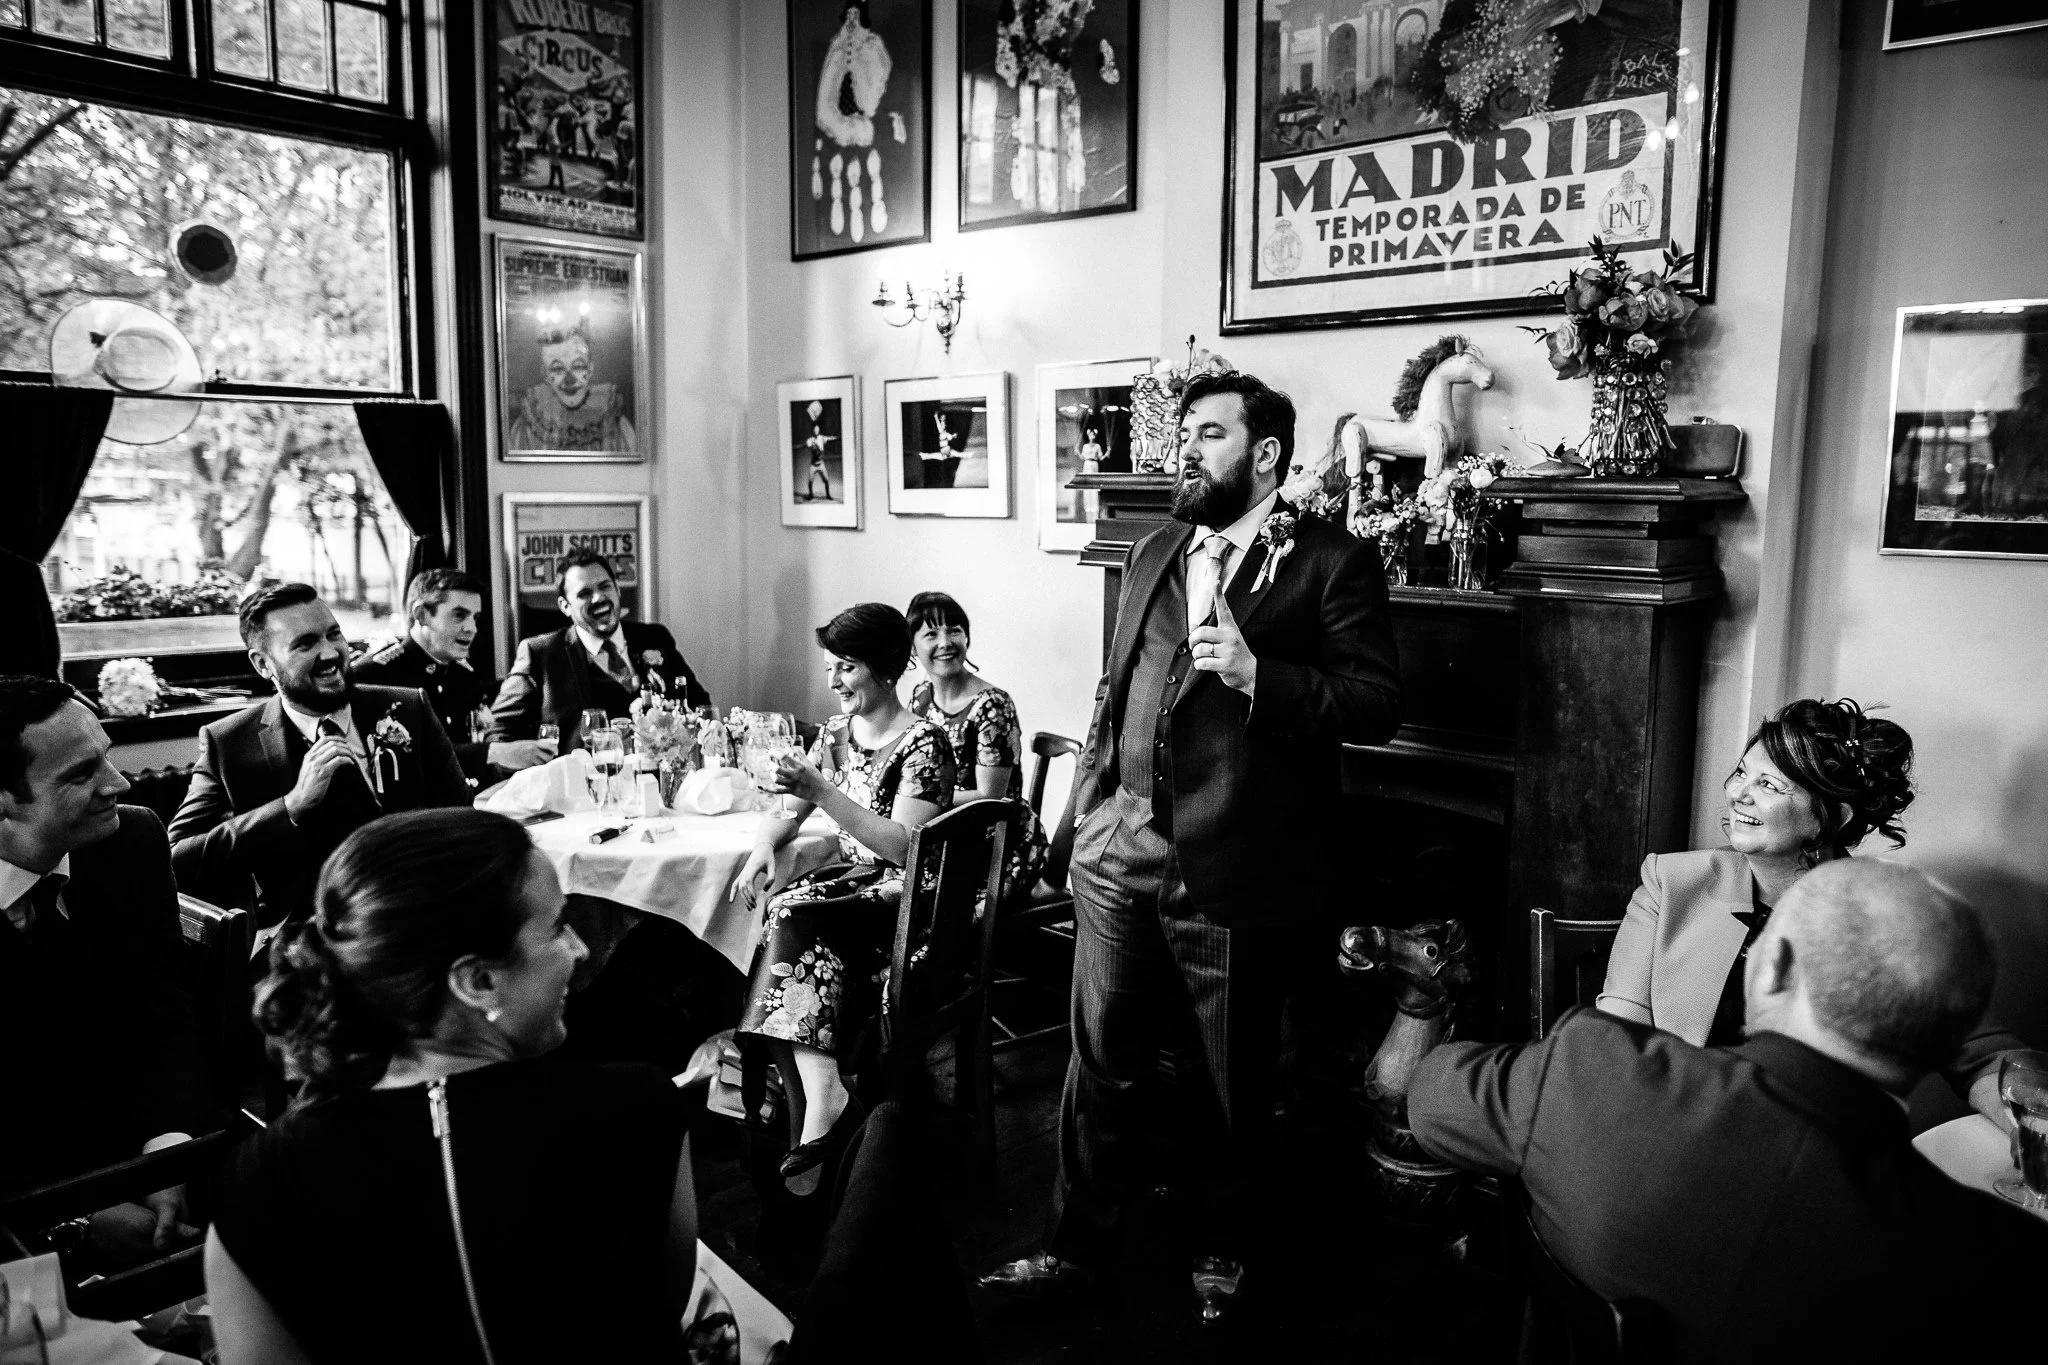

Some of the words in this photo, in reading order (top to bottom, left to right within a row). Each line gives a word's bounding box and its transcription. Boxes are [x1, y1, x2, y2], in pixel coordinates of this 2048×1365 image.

[521, 35, 603, 80] CIRCUS
[1270, 108, 1647, 218] MADRID
[1315, 191, 1526, 242] TEMPORADA
[1540, 183, 1586, 214] DE
[1609, 199, 1647, 228] PNT
[1328, 219, 1565, 268] PRIMAVERA
[521, 535, 564, 556] JOHN
[569, 534, 632, 554] SCOTTS
